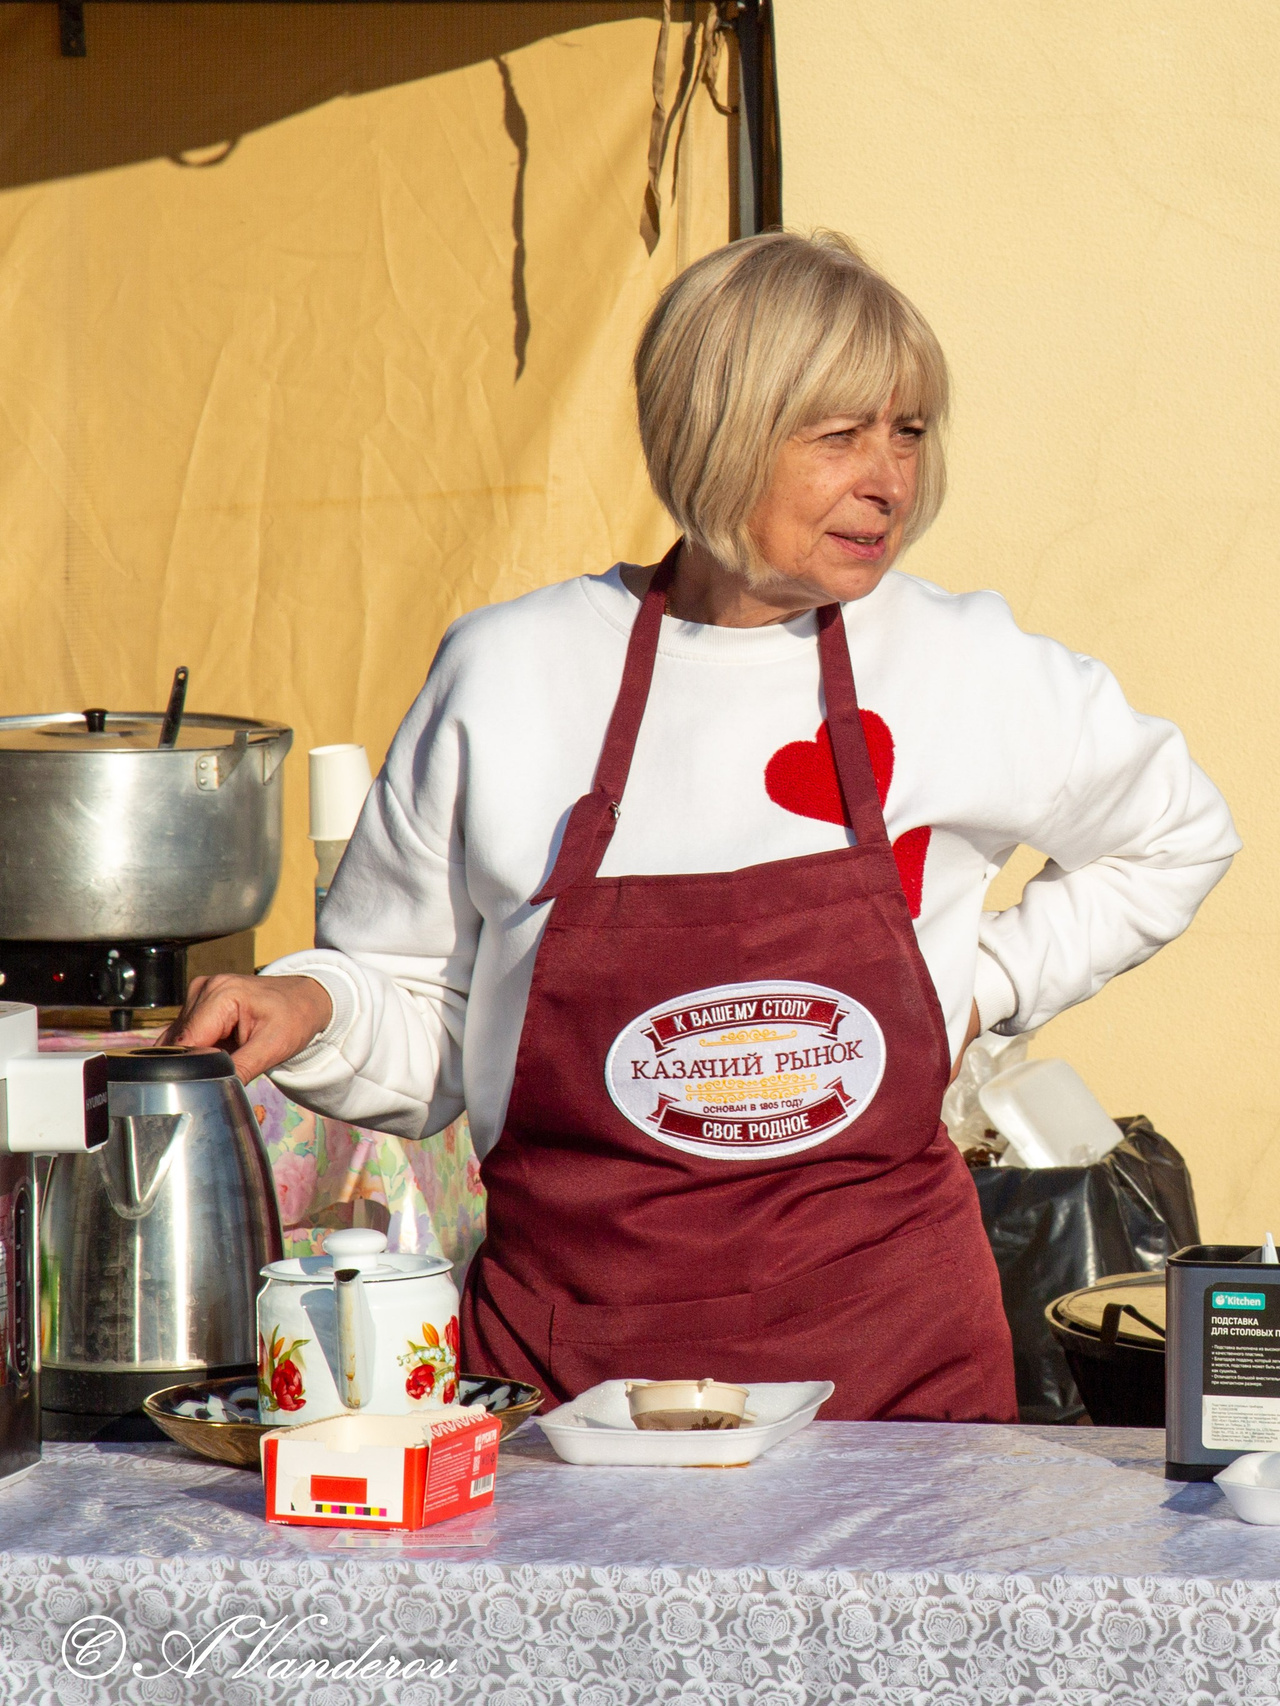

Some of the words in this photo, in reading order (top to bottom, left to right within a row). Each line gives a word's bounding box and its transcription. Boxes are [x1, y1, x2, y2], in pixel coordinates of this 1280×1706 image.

[673, 1015, 688, 1032] К
[690, 1001, 757, 1025] ВАШЕМУ
[762, 999, 813, 1018] СТОЛУ
[630, 1052, 764, 1080] КАЗАЧИЙ
[775, 1039, 864, 1073] РЫНОК
[702, 1102, 748, 1114] ОСНОВАН
[750, 1103, 757, 1112] В
[759, 1101, 779, 1111] 1805
[781, 1098, 804, 1109] ГОДУ
[702, 1120, 743, 1140] СВОЕ
[749, 1113, 812, 1140] РОДНОЕ
[1211, 1316, 1259, 1326] ПОДСТАВКА
[1211, 1327, 1229, 1336] ДЛЯ
[1230, 1328, 1273, 1338] СТОЛОВЫХ
